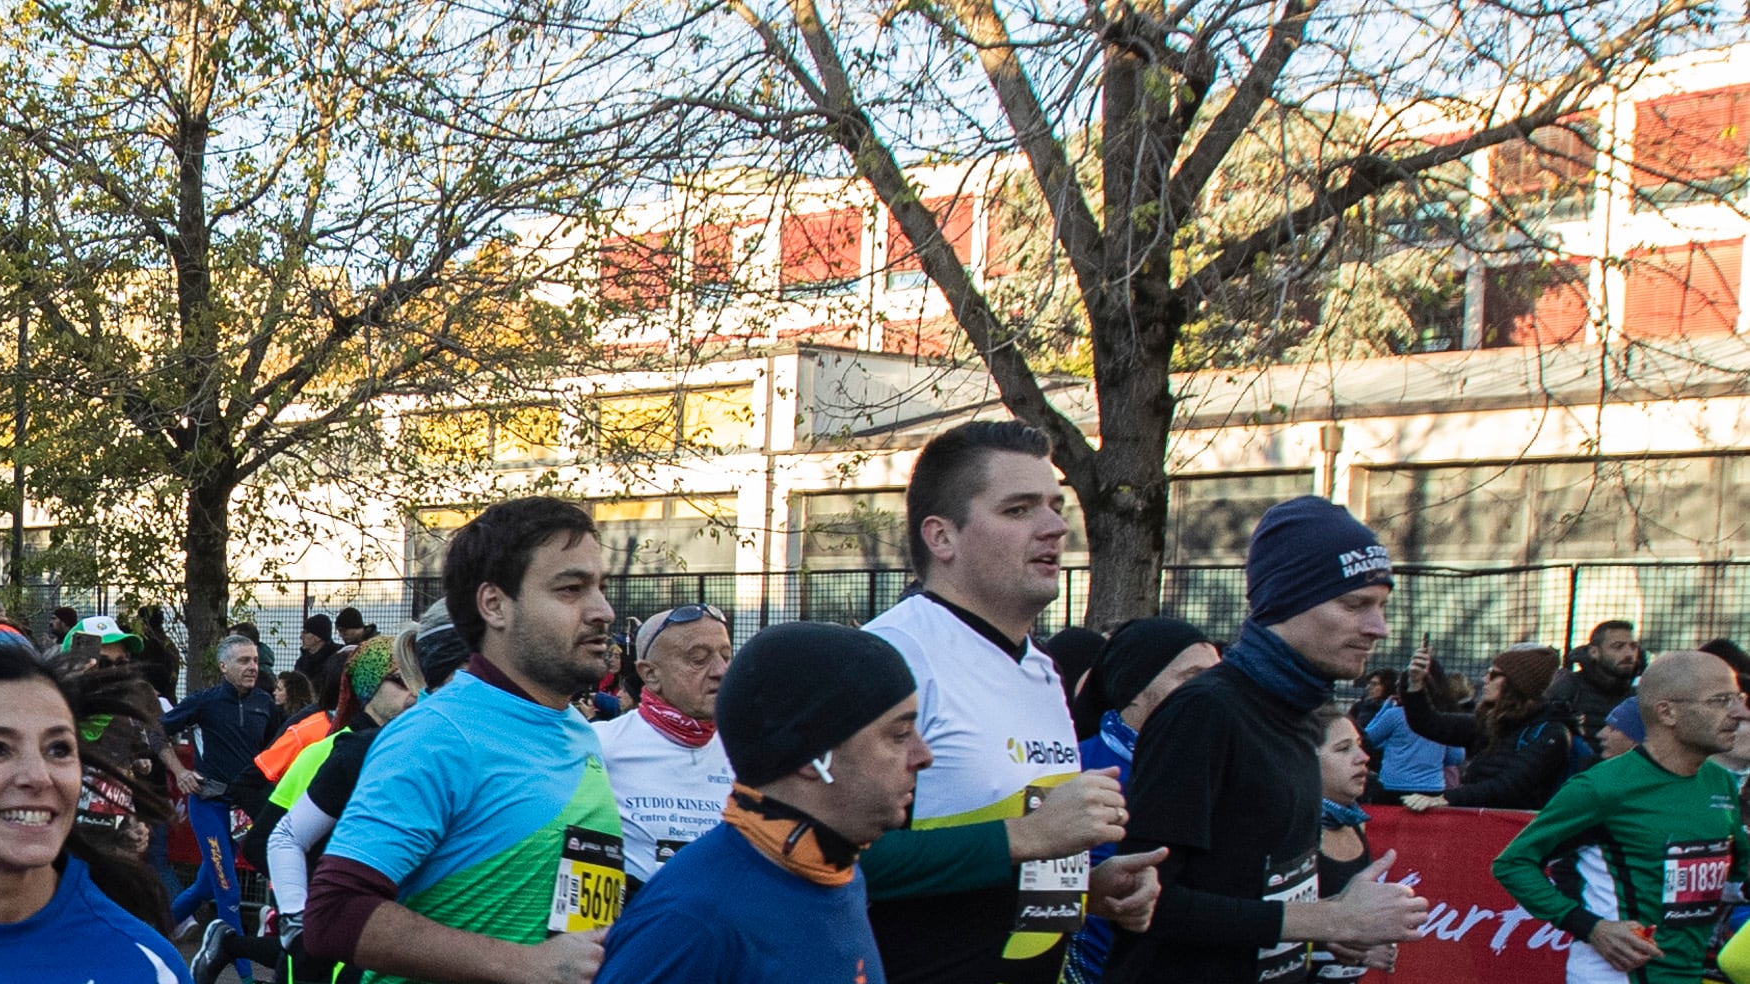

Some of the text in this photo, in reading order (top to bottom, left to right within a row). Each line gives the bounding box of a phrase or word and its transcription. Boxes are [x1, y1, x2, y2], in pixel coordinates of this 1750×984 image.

[625, 797, 722, 812] STUDIO KINESIS
[631, 812, 718, 827] Centro di recupero
